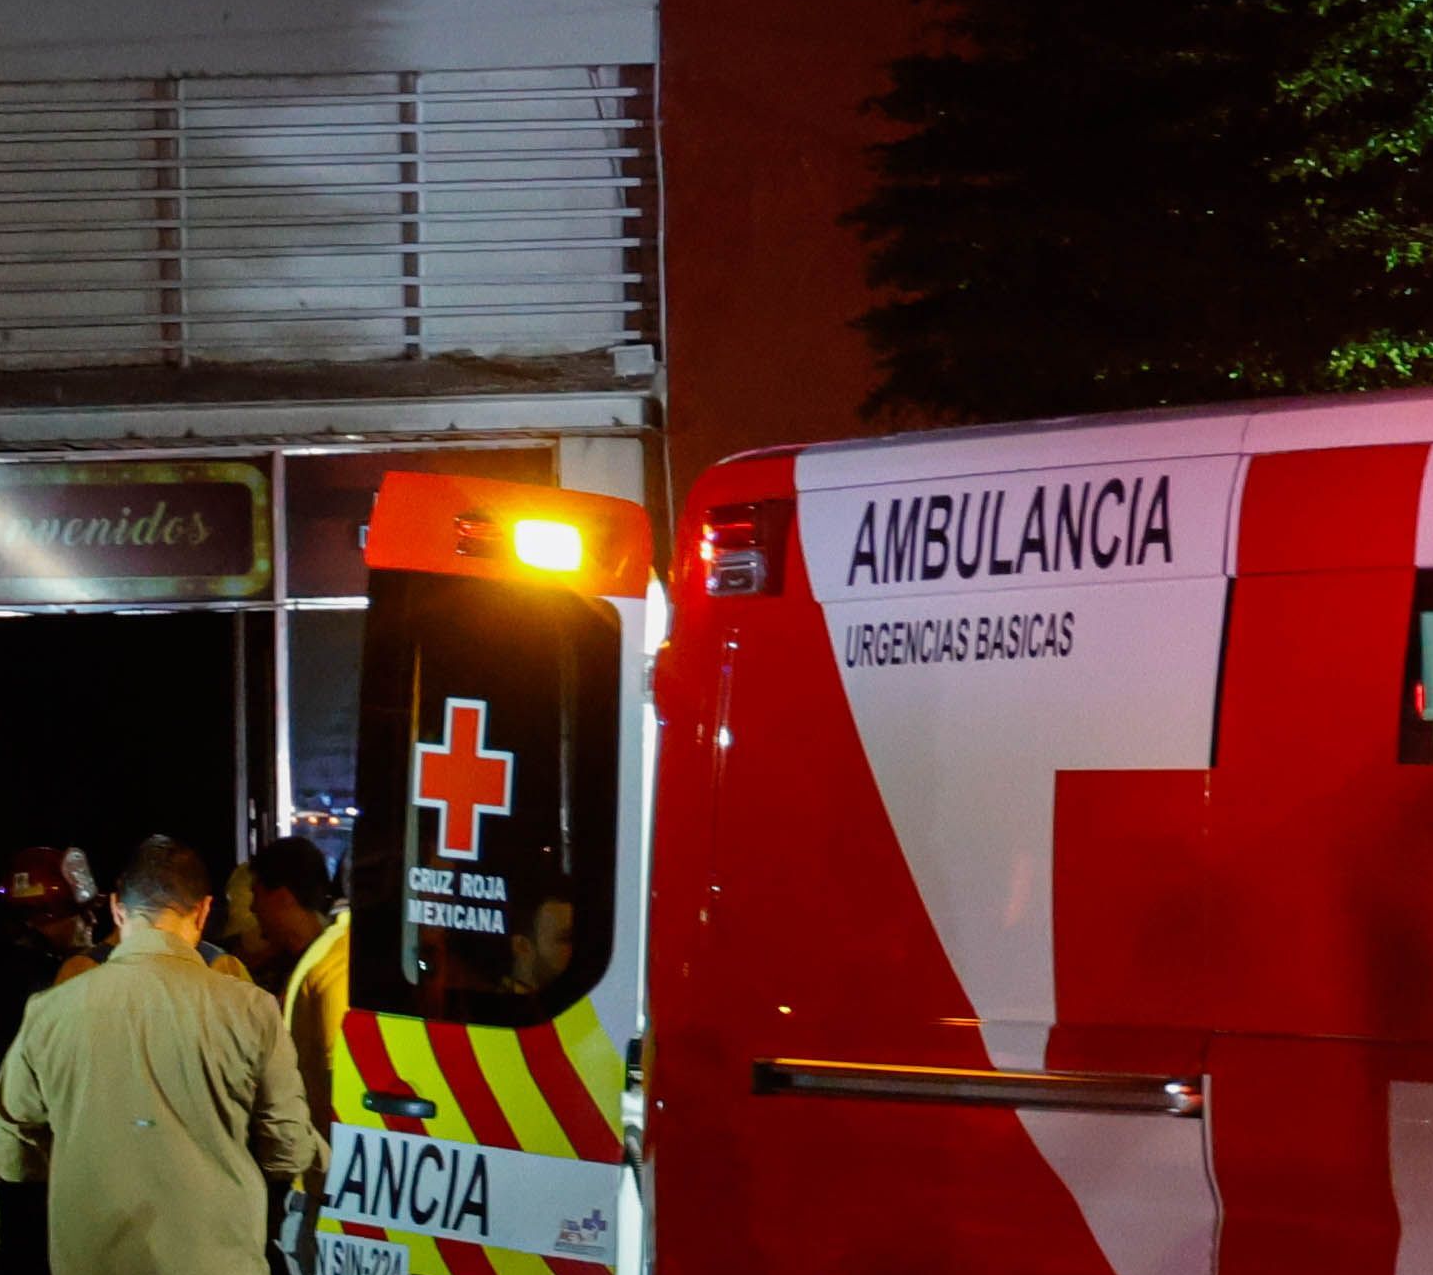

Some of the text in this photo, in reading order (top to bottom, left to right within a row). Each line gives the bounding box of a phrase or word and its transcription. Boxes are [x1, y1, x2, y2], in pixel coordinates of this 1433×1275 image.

[846, 473, 1174, 586] AMBULANCIA
[845, 611, 1075, 669] URGENCIAS BASICAS
[408, 866, 508, 903] CRUZ ROJA
[407, 898, 507, 935] MEXICANA
